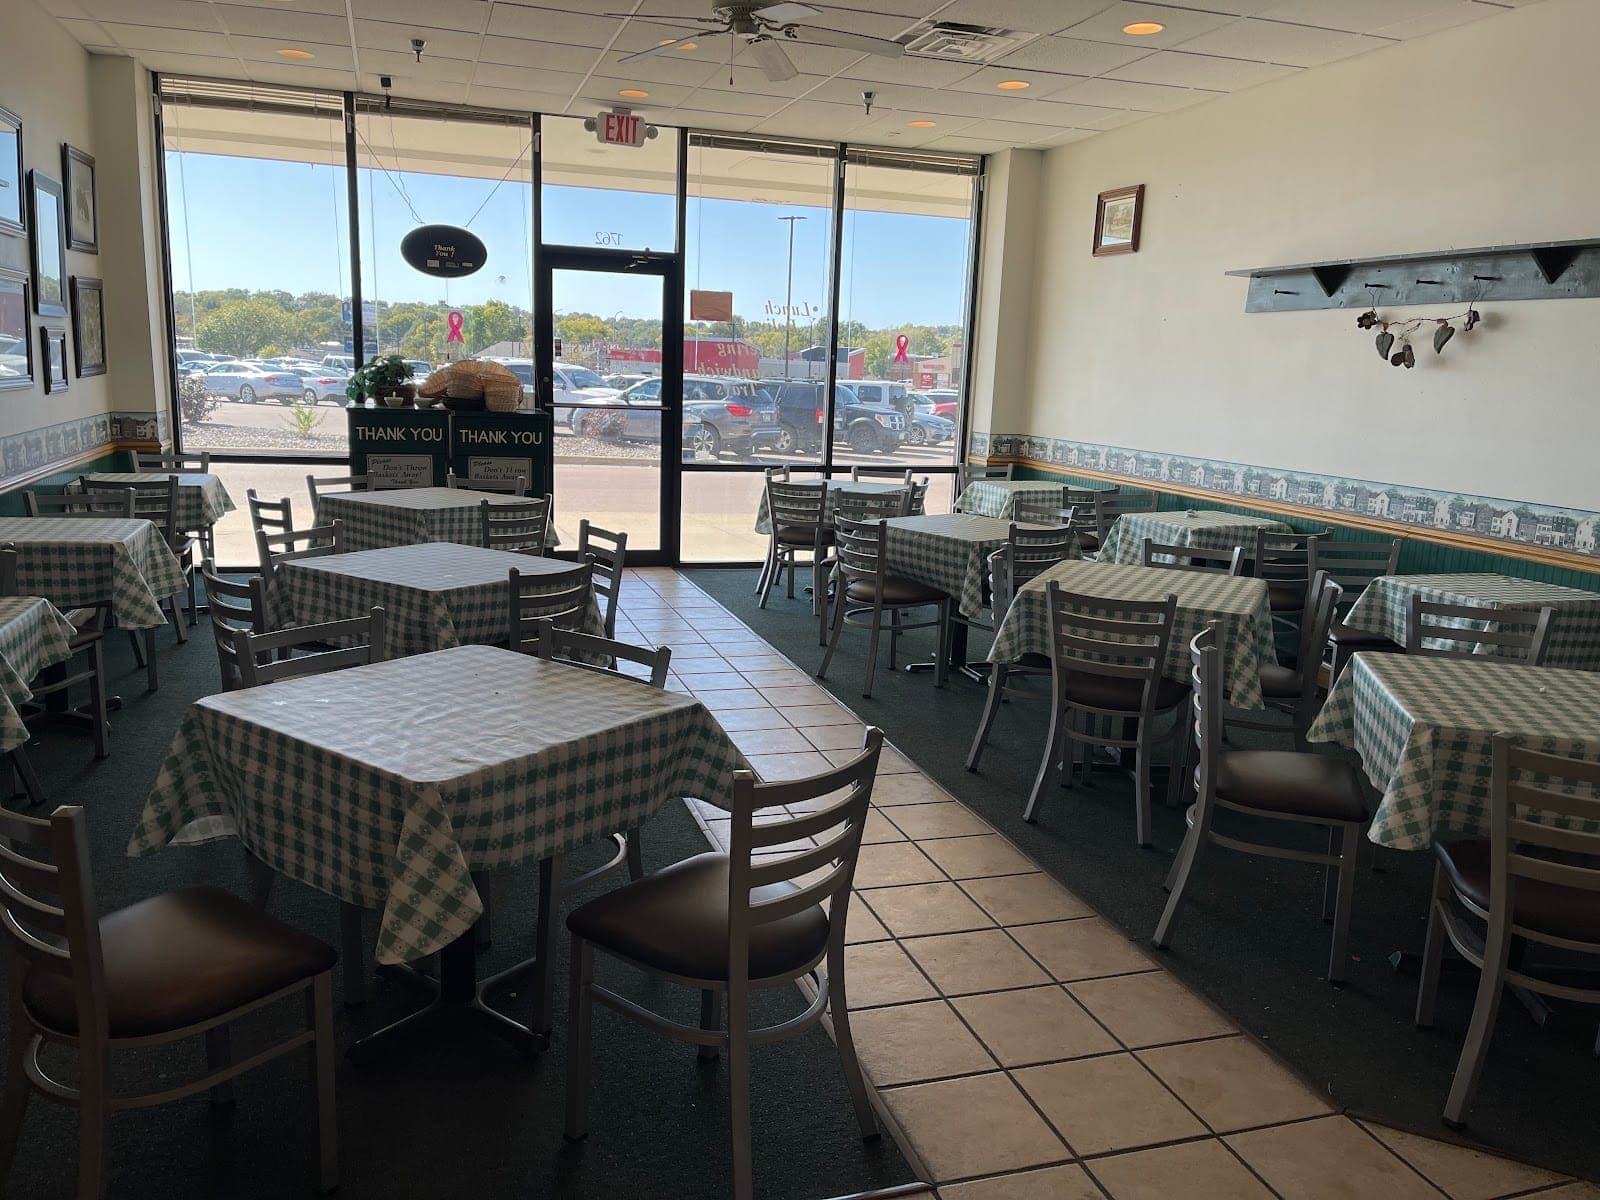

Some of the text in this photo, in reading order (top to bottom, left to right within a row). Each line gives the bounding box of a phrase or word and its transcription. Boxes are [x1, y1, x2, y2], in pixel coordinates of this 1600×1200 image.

[605, 114, 640, 144] EXIT
[433, 244, 456, 252] Thank
[355, 426, 443, 442] THANK YOU
[458, 429, 543, 445] THANK YOU
